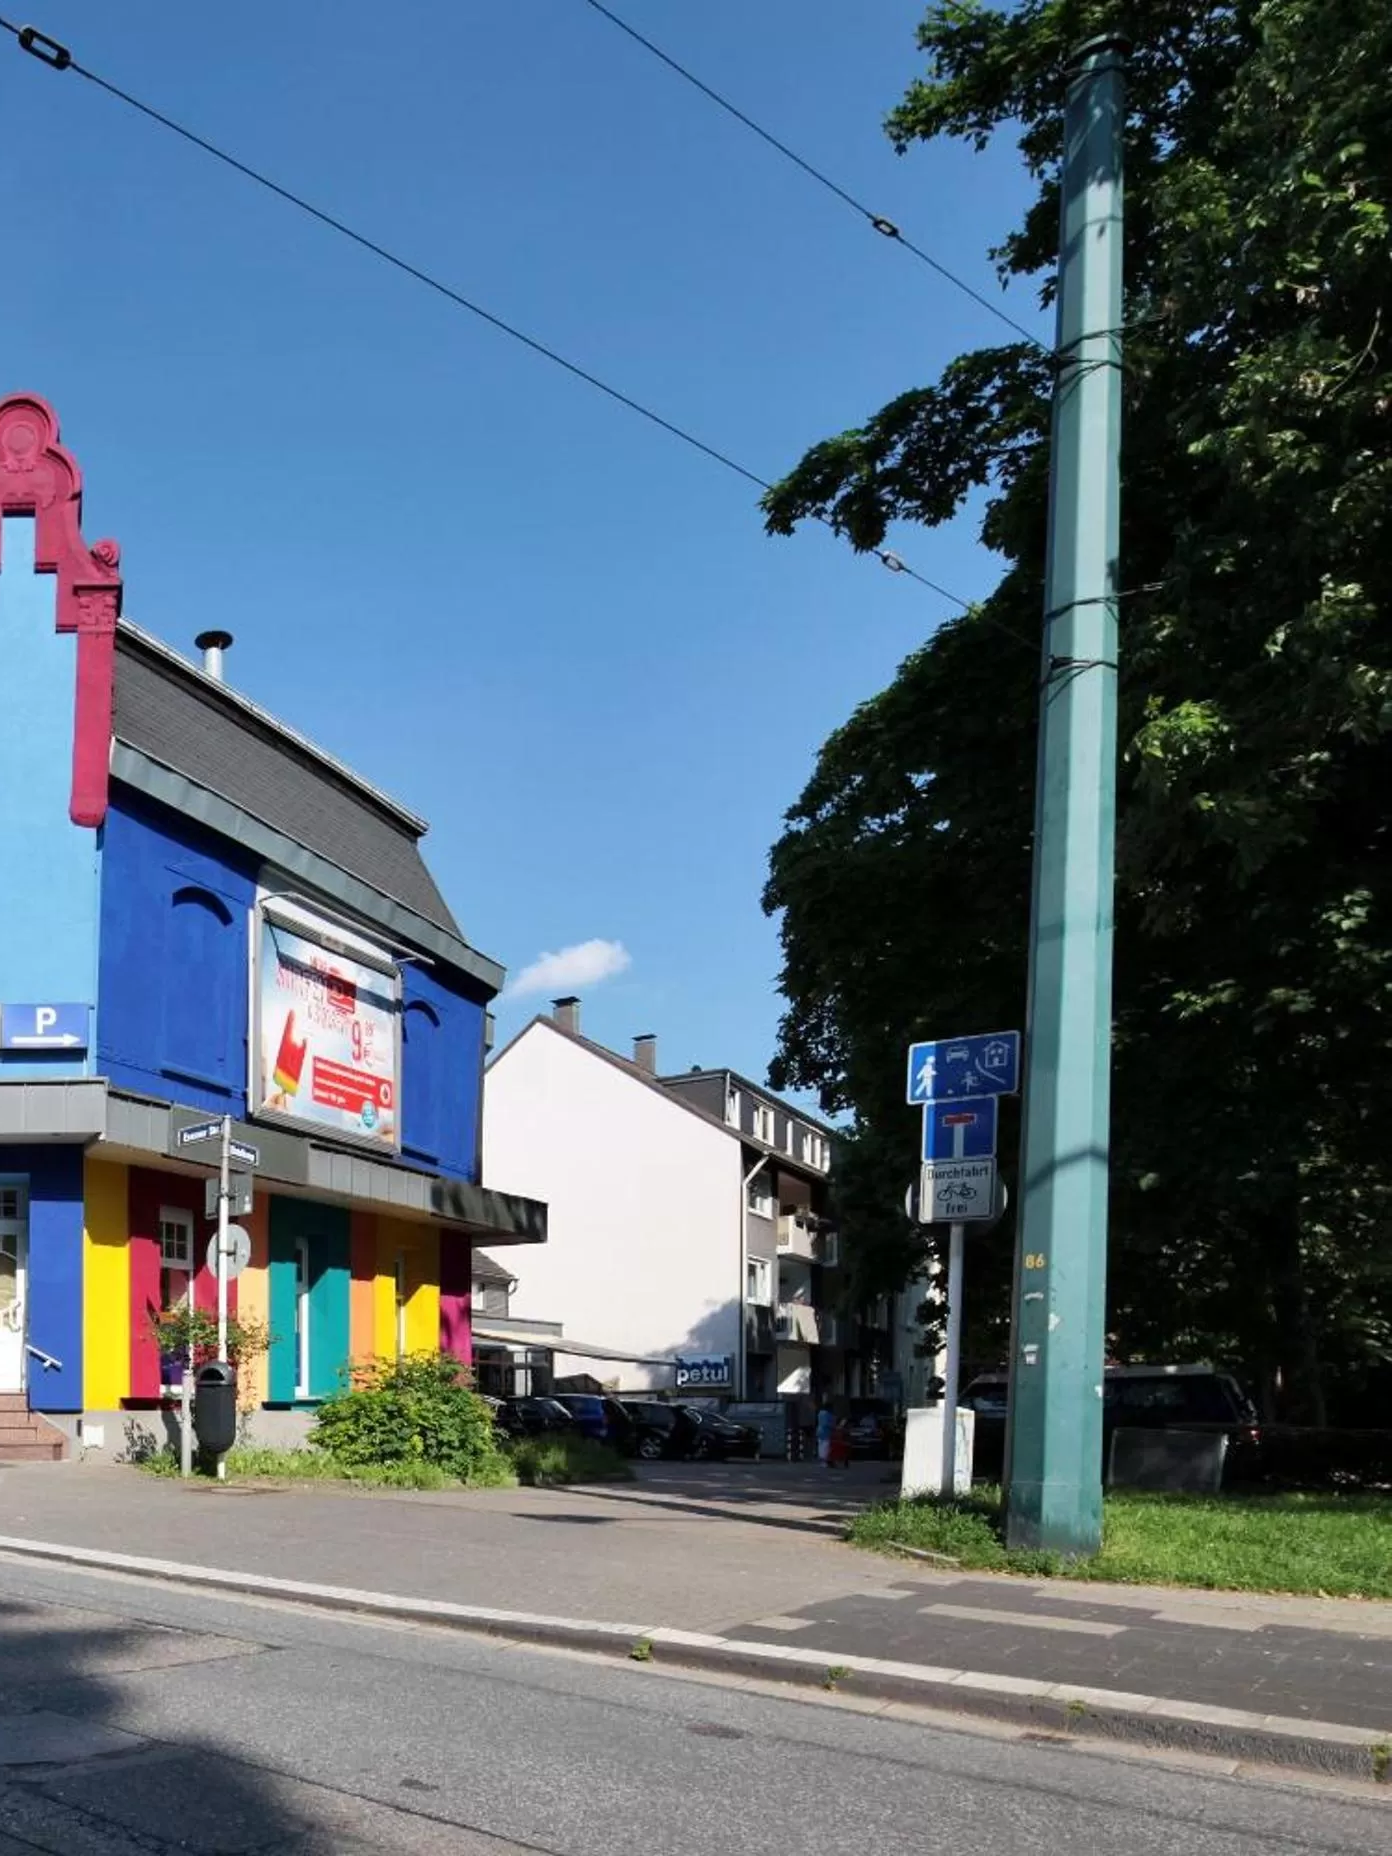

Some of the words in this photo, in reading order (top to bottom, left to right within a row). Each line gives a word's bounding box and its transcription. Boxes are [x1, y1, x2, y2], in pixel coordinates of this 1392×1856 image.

[36, 1007, 57, 1035] P
[927, 1165, 989, 1180] Durchfahrt
[946, 1203, 968, 1215] frei
[677, 1366, 728, 1385] petul
